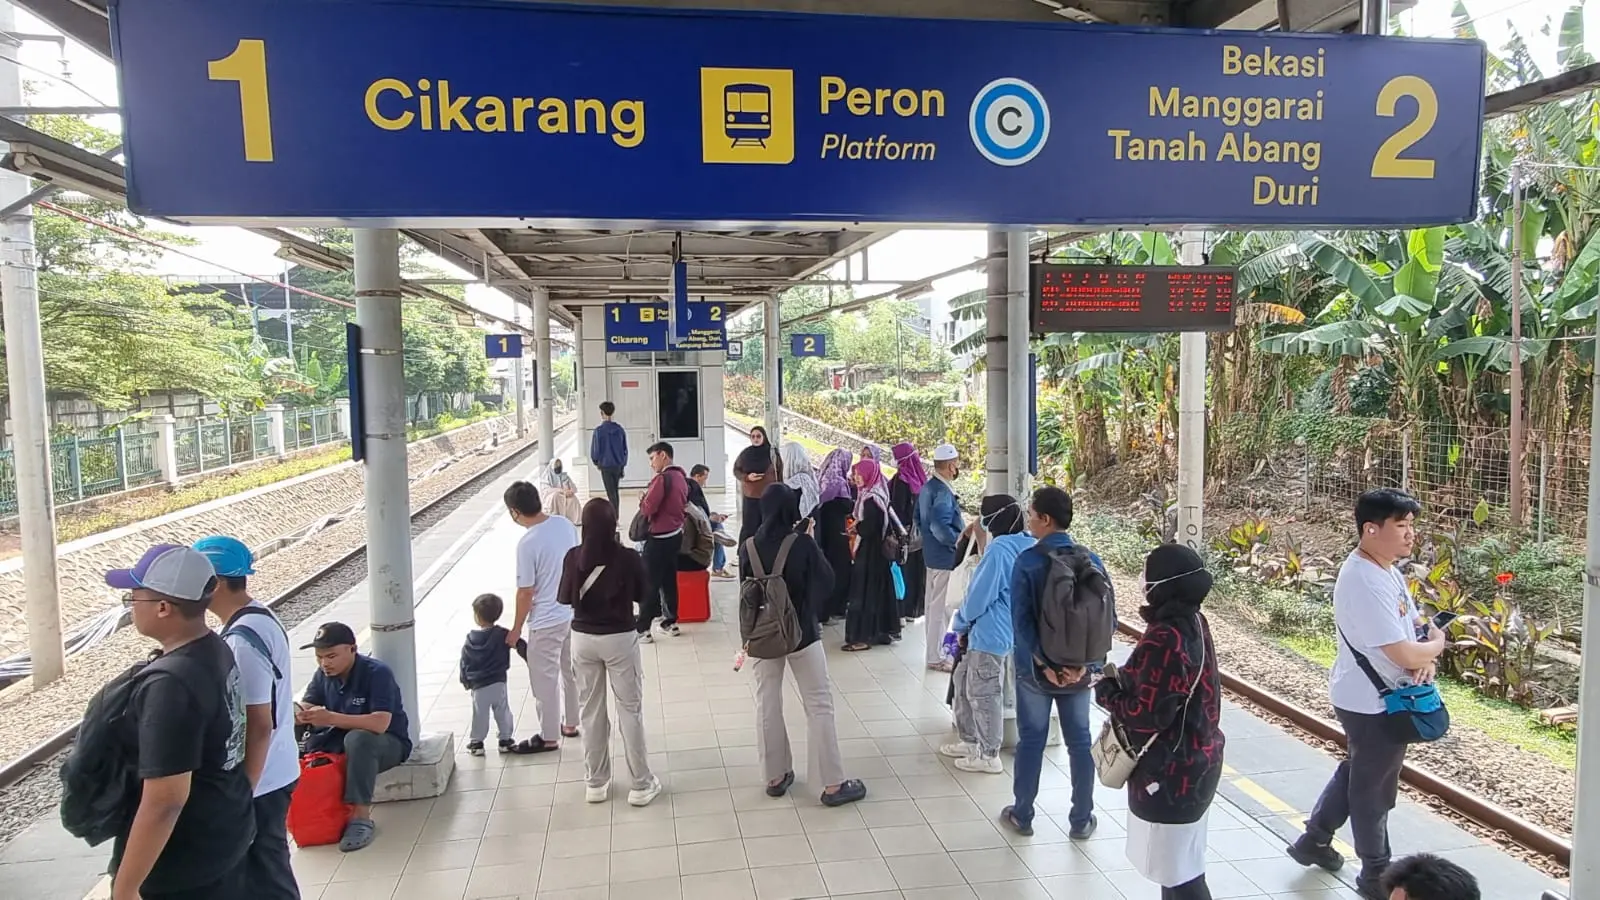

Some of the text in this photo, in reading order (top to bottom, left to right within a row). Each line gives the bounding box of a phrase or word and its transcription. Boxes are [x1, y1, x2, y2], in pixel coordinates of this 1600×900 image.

[1222, 44, 1326, 77] Bekasi
[207, 38, 275, 162] 1
[820, 76, 946, 117] Peron
[1149, 86, 1324, 127] Manggarai
[364, 78, 646, 148] Cikarang
[997, 106, 1022, 136] C
[1370, 75, 1440, 179] 2
[821, 134, 937, 162] Platform
[1107, 129, 1321, 171] Tanah Abang
[1253, 175, 1319, 206] Duri
[611, 307, 620, 323] 1
[710, 306, 722, 321] 2
[498, 337, 508, 353] 1
[610, 335, 649, 345] Cikarang
[803, 336, 815, 352] 2
